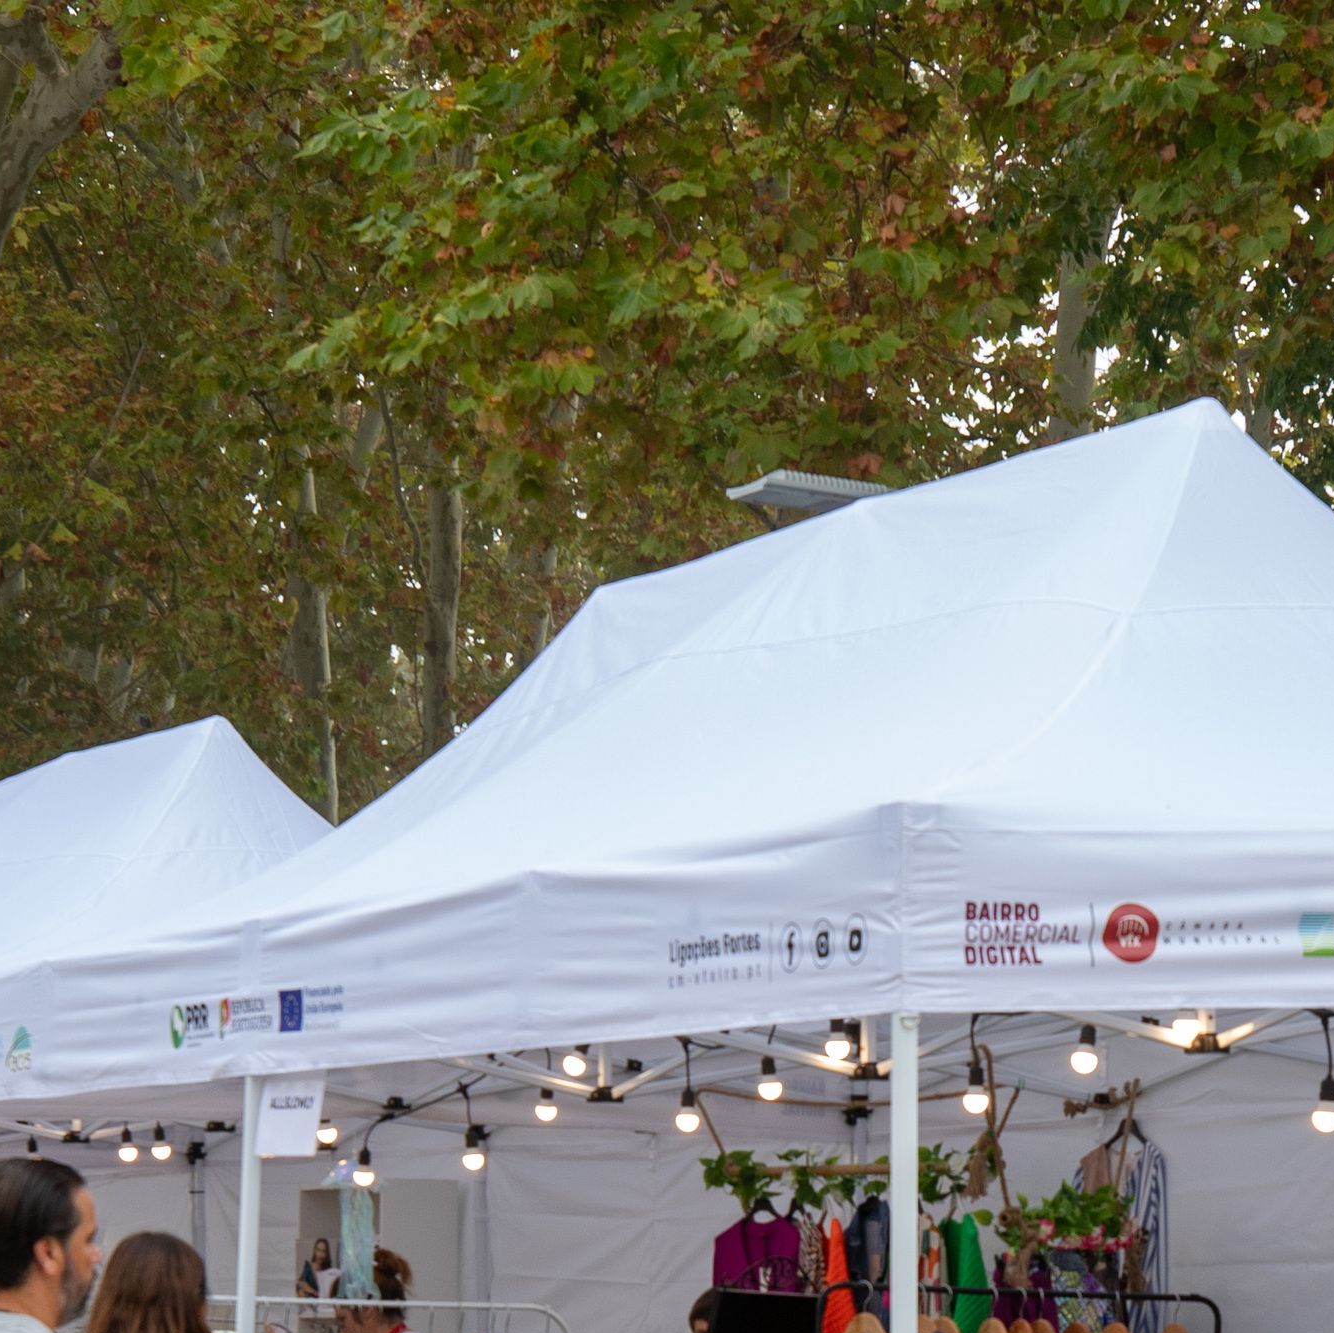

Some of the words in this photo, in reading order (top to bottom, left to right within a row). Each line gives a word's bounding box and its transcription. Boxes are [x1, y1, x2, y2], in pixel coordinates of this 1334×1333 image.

[965, 901, 1040, 922] BAIRRO
[965, 923, 1081, 945] COMERCIAL
[965, 945, 1043, 966] DIGITAL
